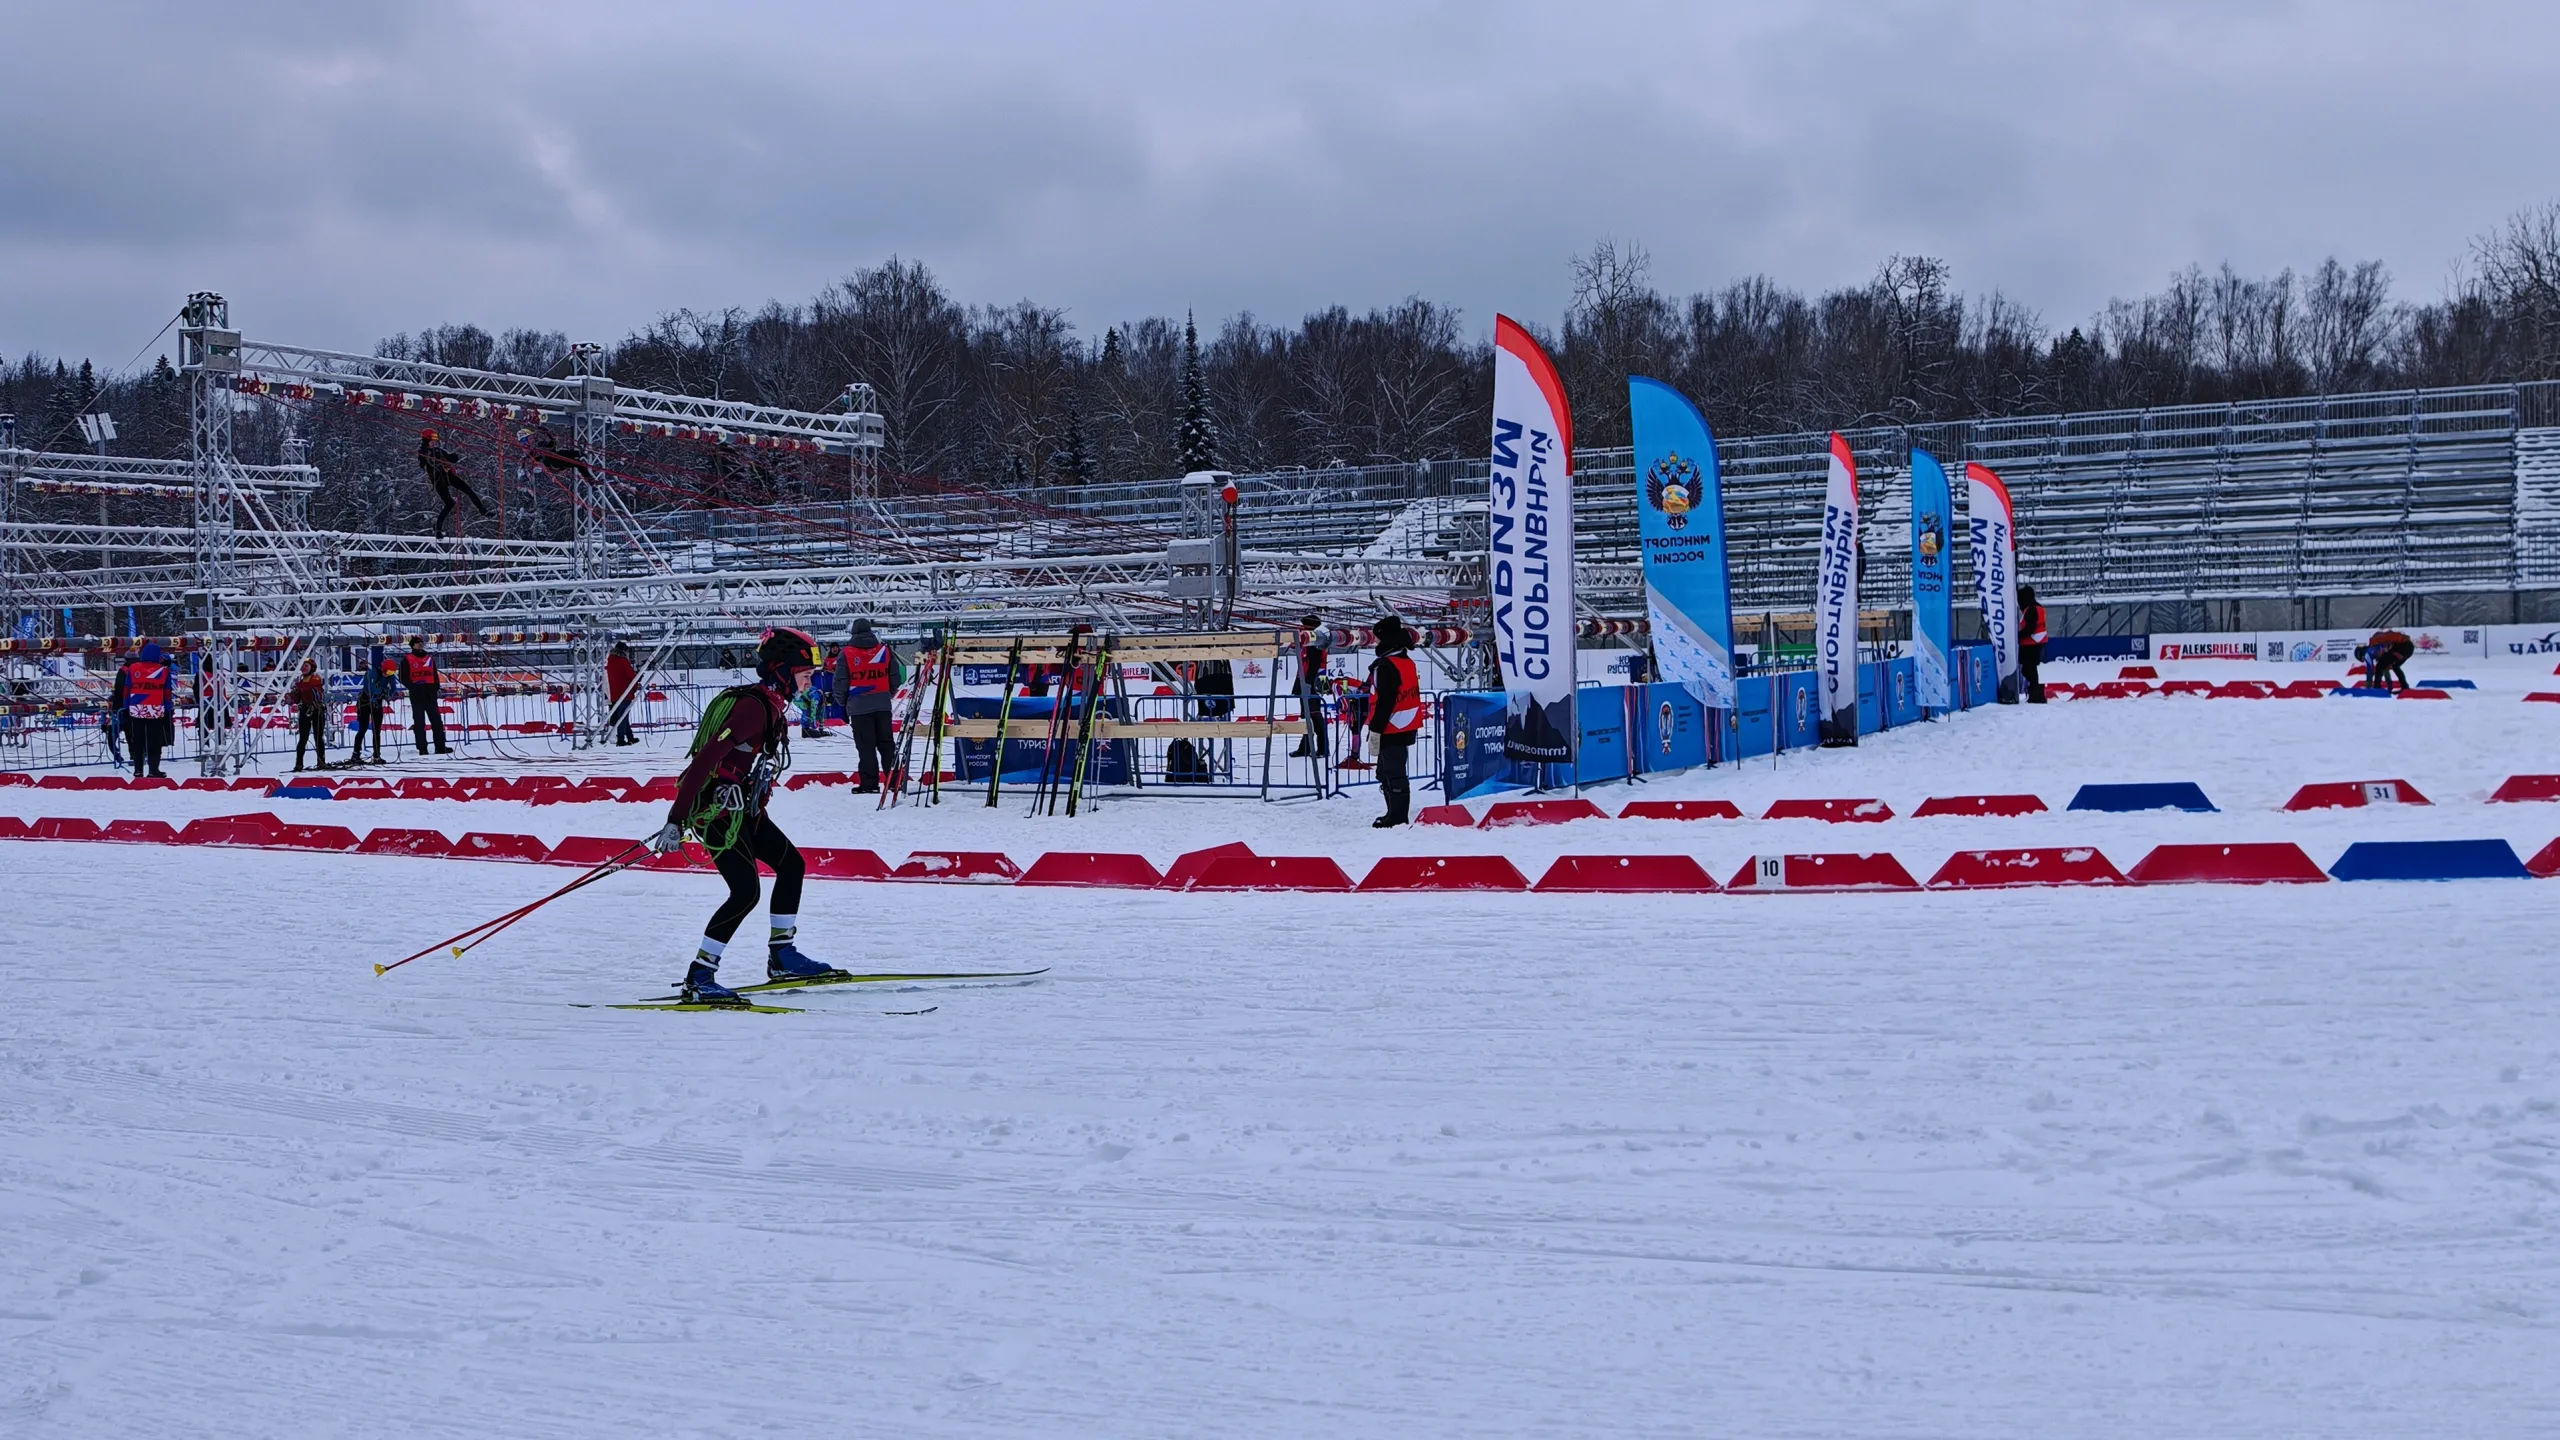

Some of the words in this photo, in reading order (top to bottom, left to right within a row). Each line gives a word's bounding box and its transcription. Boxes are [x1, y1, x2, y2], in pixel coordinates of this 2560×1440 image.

[3, 639, 9, 648] 1
[43, 639, 50, 648] 2
[103, 638, 110, 648] 3
[134, 638, 141, 646] 4
[172, 638, 179, 646] 5
[277, 638, 283, 646] 8
[2183, 643, 2257, 656] ALEKSRIFLE.RU
[1475, 725, 1506, 739] СПОРТИВН
[2373, 787, 2390, 799] 31
[1762, 860, 1779, 877] 10
